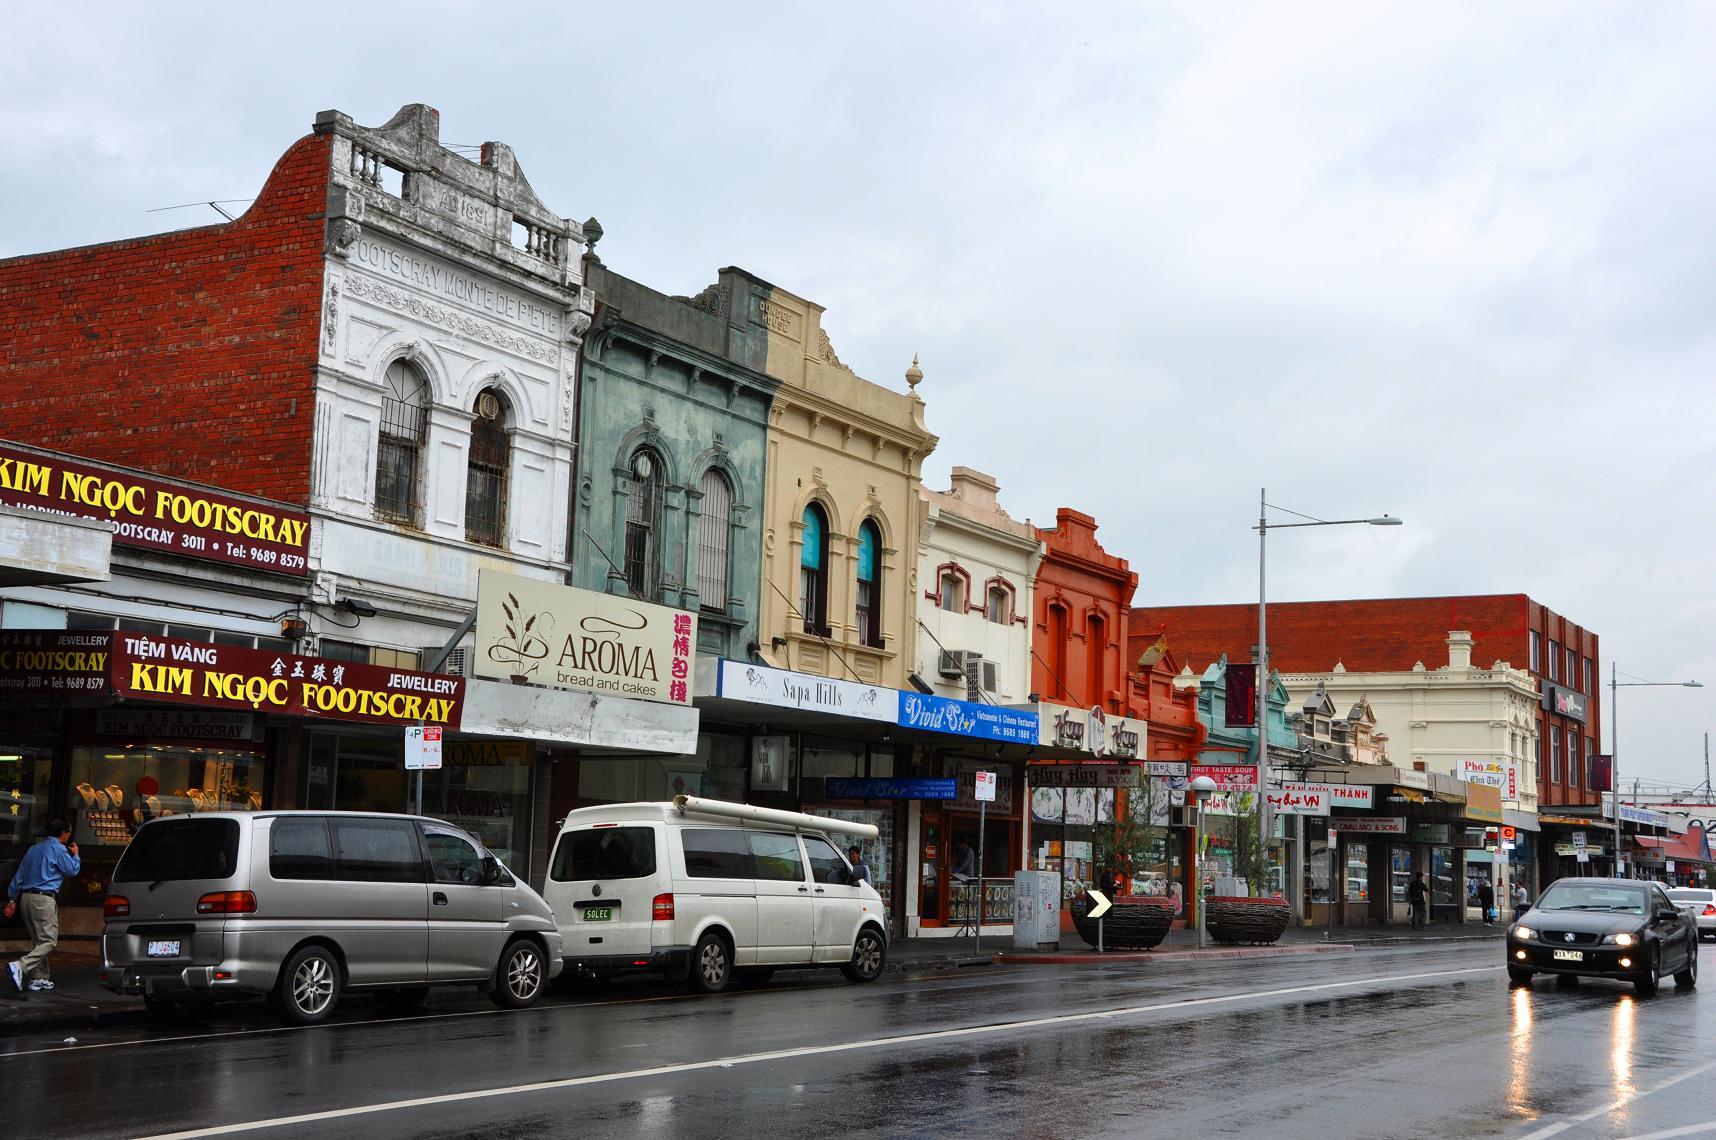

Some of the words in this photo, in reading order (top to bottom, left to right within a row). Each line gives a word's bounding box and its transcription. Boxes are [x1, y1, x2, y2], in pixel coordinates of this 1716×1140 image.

[461, 198, 488, 227] 1891
[444, 270, 494, 310] MONTE
[497, 290, 515, 318] DE
[760, 301, 792, 324] DUNDEE
[761, 312, 788, 333] HOUSE
[0, 457, 52, 496] KIM
[60, 470, 146, 518] NGỌC
[155, 490, 308, 546] FOOTSCRAY
[105, 519, 174, 544] OOTSCRAY
[181, 534, 206, 551] 3011
[226, 542, 247, 559] Tel:
[250, 548, 277, 564] 9689
[280, 552, 305, 569] 8579
[57, 635, 109, 646] JEWELLERY
[125, 636, 165, 660] TIỆM
[171, 642, 218, 665] VÀNG
[15, 651, 108, 671] FOOTSCRAY
[556, 633, 659, 682] AROMA
[66, 677, 84, 689] 9689
[86, 678, 104, 689] 8579
[130, 663, 194, 696] KIM
[203, 671, 288, 709] NGỌC
[301, 682, 455, 723] FOOTSCRAY
[387, 674, 458, 695] JEWELLERY
[557, 670, 594, 688] bread
[597, 677, 619, 691] and
[622, 681, 657, 696] cakes
[783, 677, 811, 707] Sapa
[816, 682, 842, 706] Hills
[905, 695, 945, 729] Vivid
[1002, 714, 1017, 726] Chinese
[171, 724, 244, 738] FOOTSCRAY
[1303, 794, 1319, 807] VN
[1381, 824, 1399, 832] SONS
